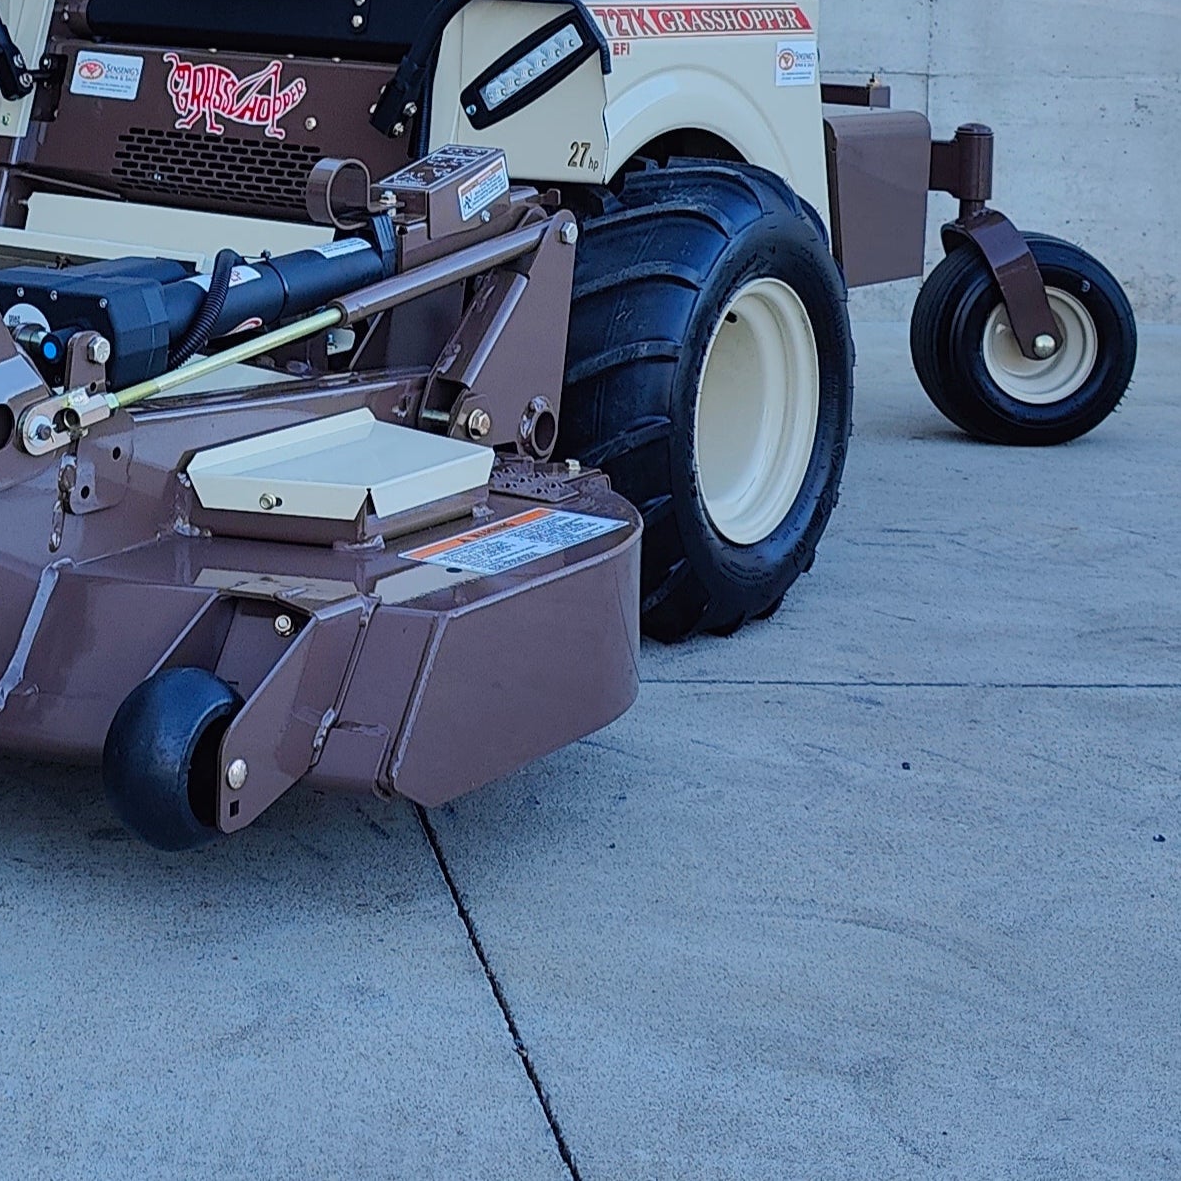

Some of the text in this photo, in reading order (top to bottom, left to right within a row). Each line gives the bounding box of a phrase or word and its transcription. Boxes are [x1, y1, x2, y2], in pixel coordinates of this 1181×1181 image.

[592, 7, 804, 37] 727K GRASSHOPPER
[613, 42, 630, 56] EFI
[568, 141, 599, 172] 27 hp
